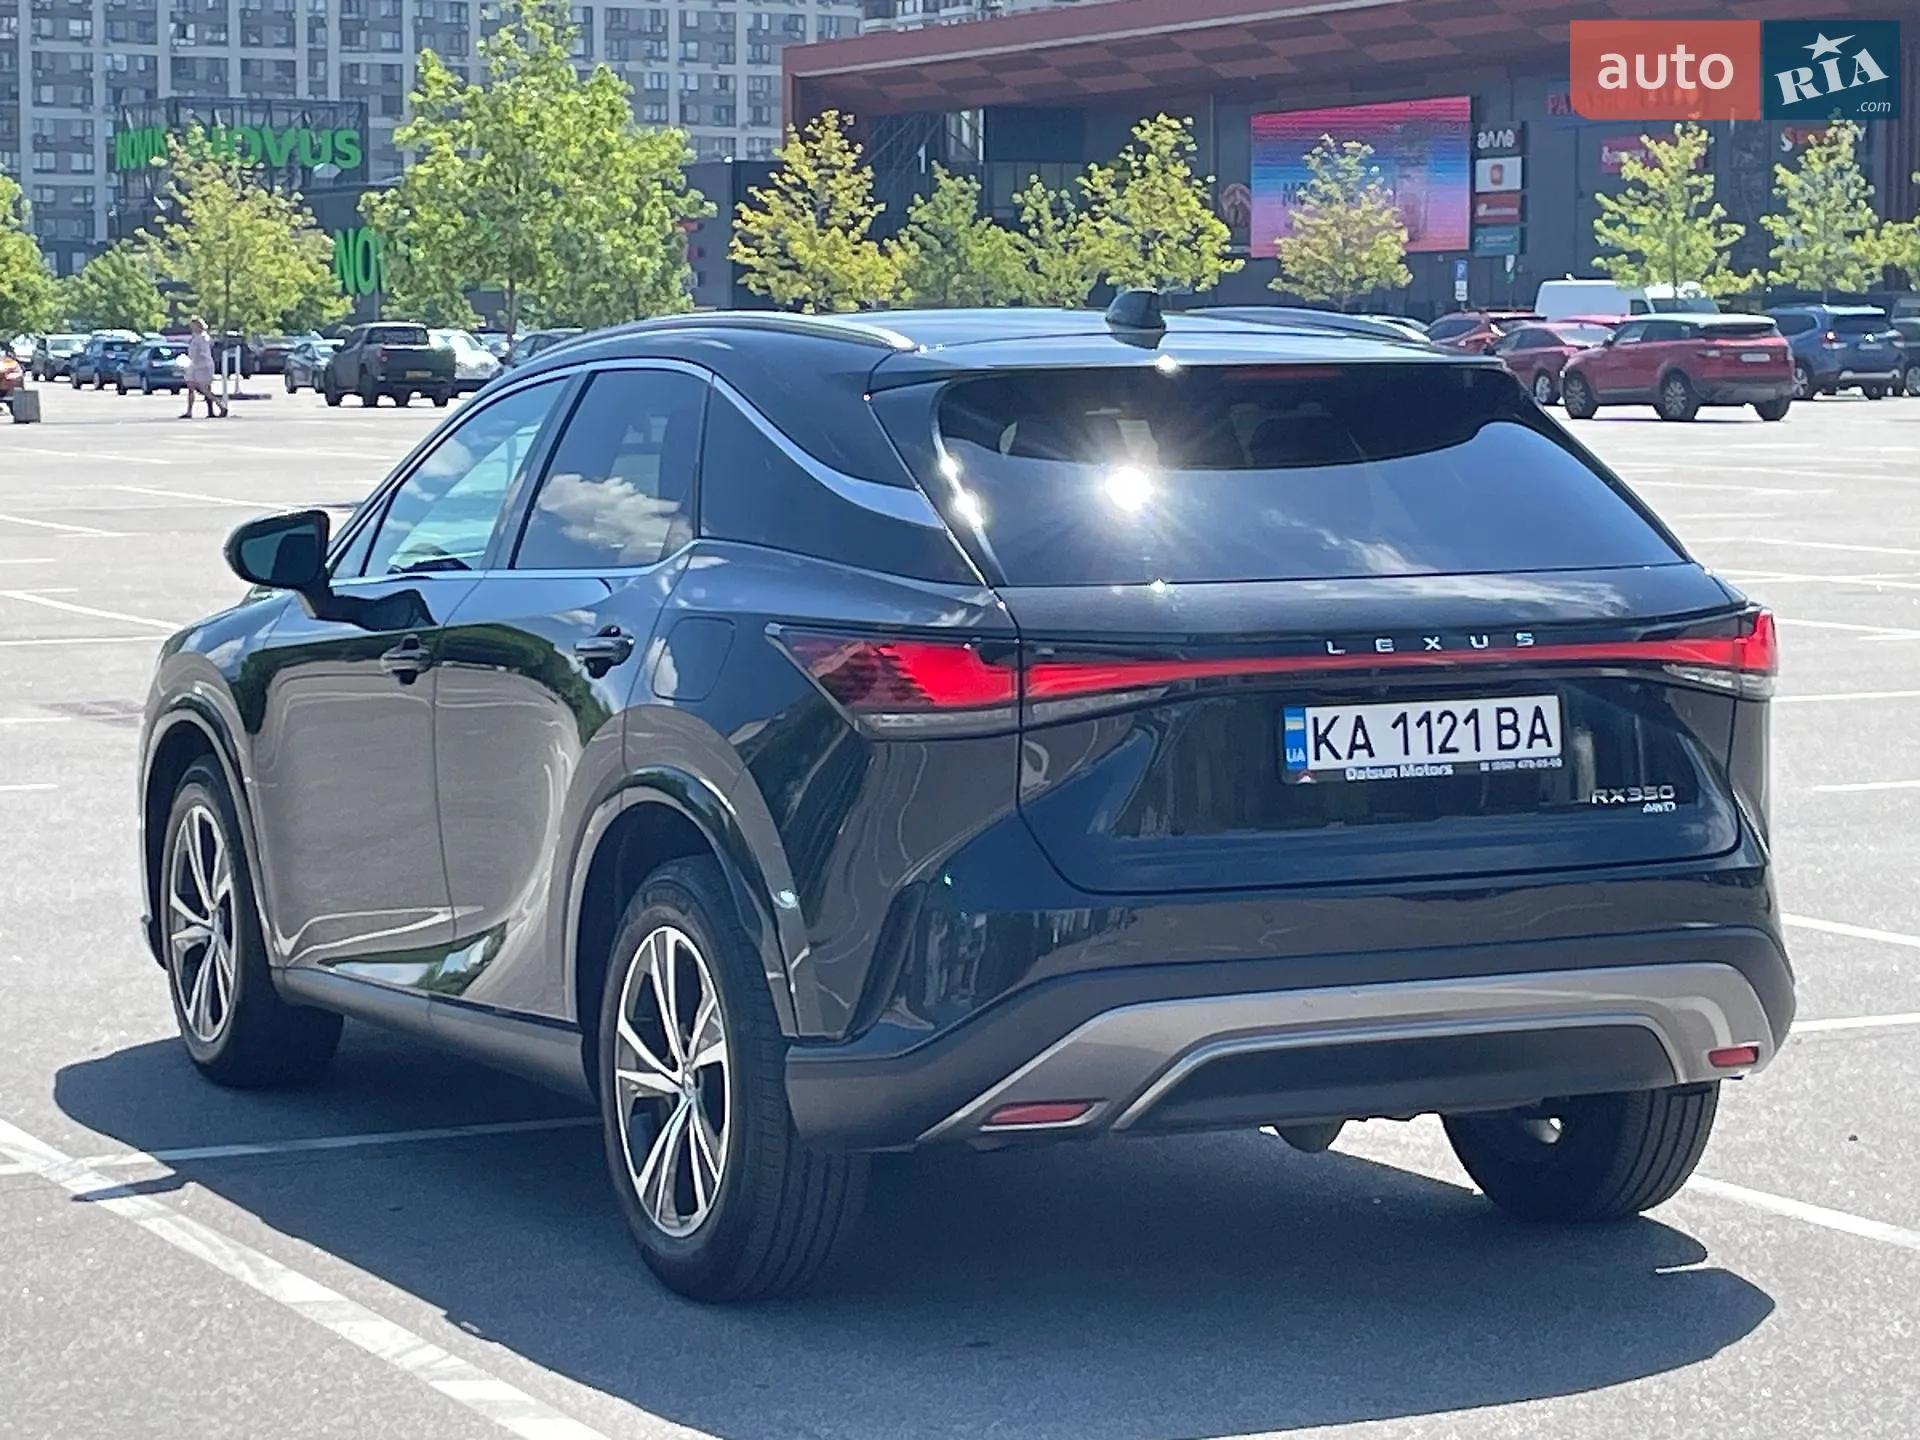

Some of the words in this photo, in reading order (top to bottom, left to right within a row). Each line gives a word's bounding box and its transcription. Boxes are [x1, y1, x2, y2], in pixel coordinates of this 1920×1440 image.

[1326, 632, 1535, 655] LEXUS
[1313, 714, 1376, 762] KA
[1391, 707, 1481, 757] 1121
[1495, 705, 1553, 751] BA
[1286, 748, 1306, 763] UA
[1400, 763, 1454, 778] Motors
[1592, 785, 1675, 804] RX350
